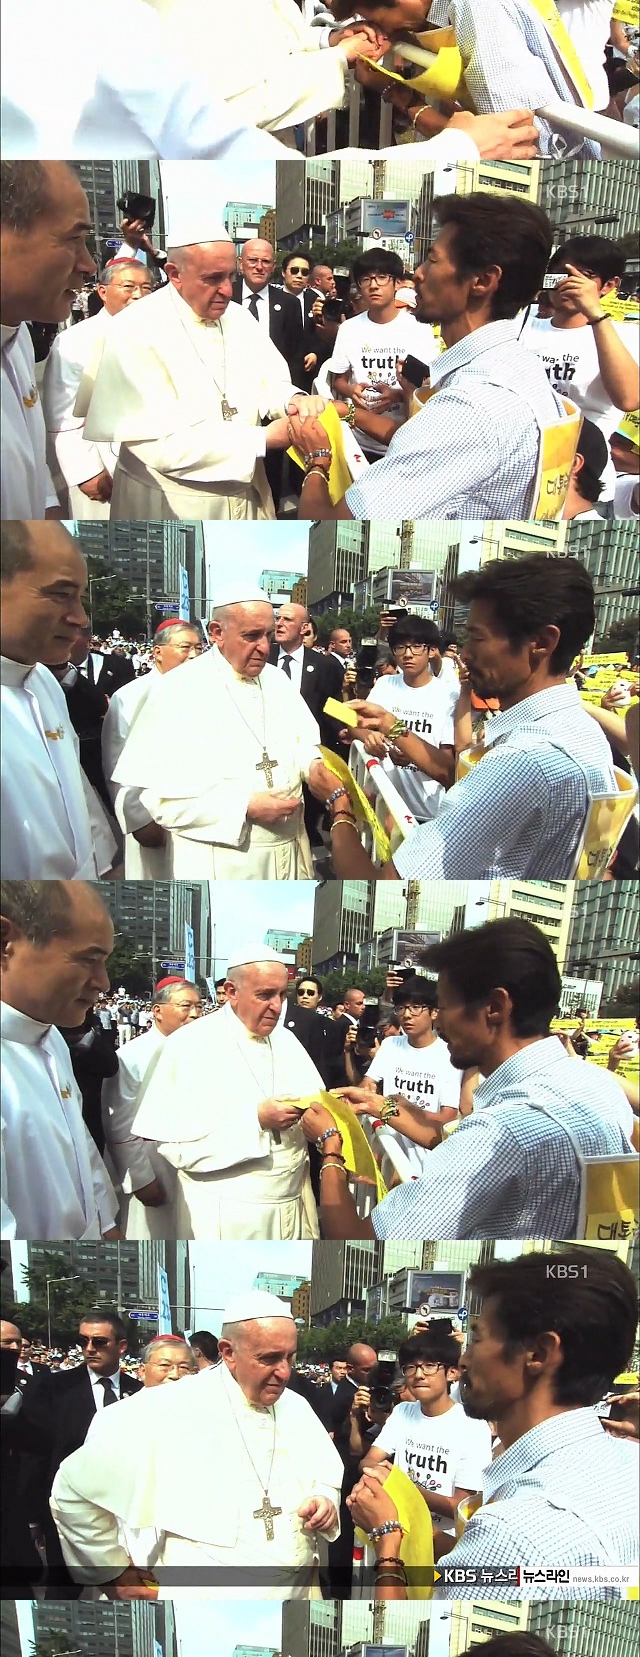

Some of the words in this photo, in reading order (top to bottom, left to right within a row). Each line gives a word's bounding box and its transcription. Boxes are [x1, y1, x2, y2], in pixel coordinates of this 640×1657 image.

[361, 346, 372, 354] We
[392, 346, 406, 354] the
[394, 1075, 435, 1095] truth
[405, 1448, 448, 1473] truth
